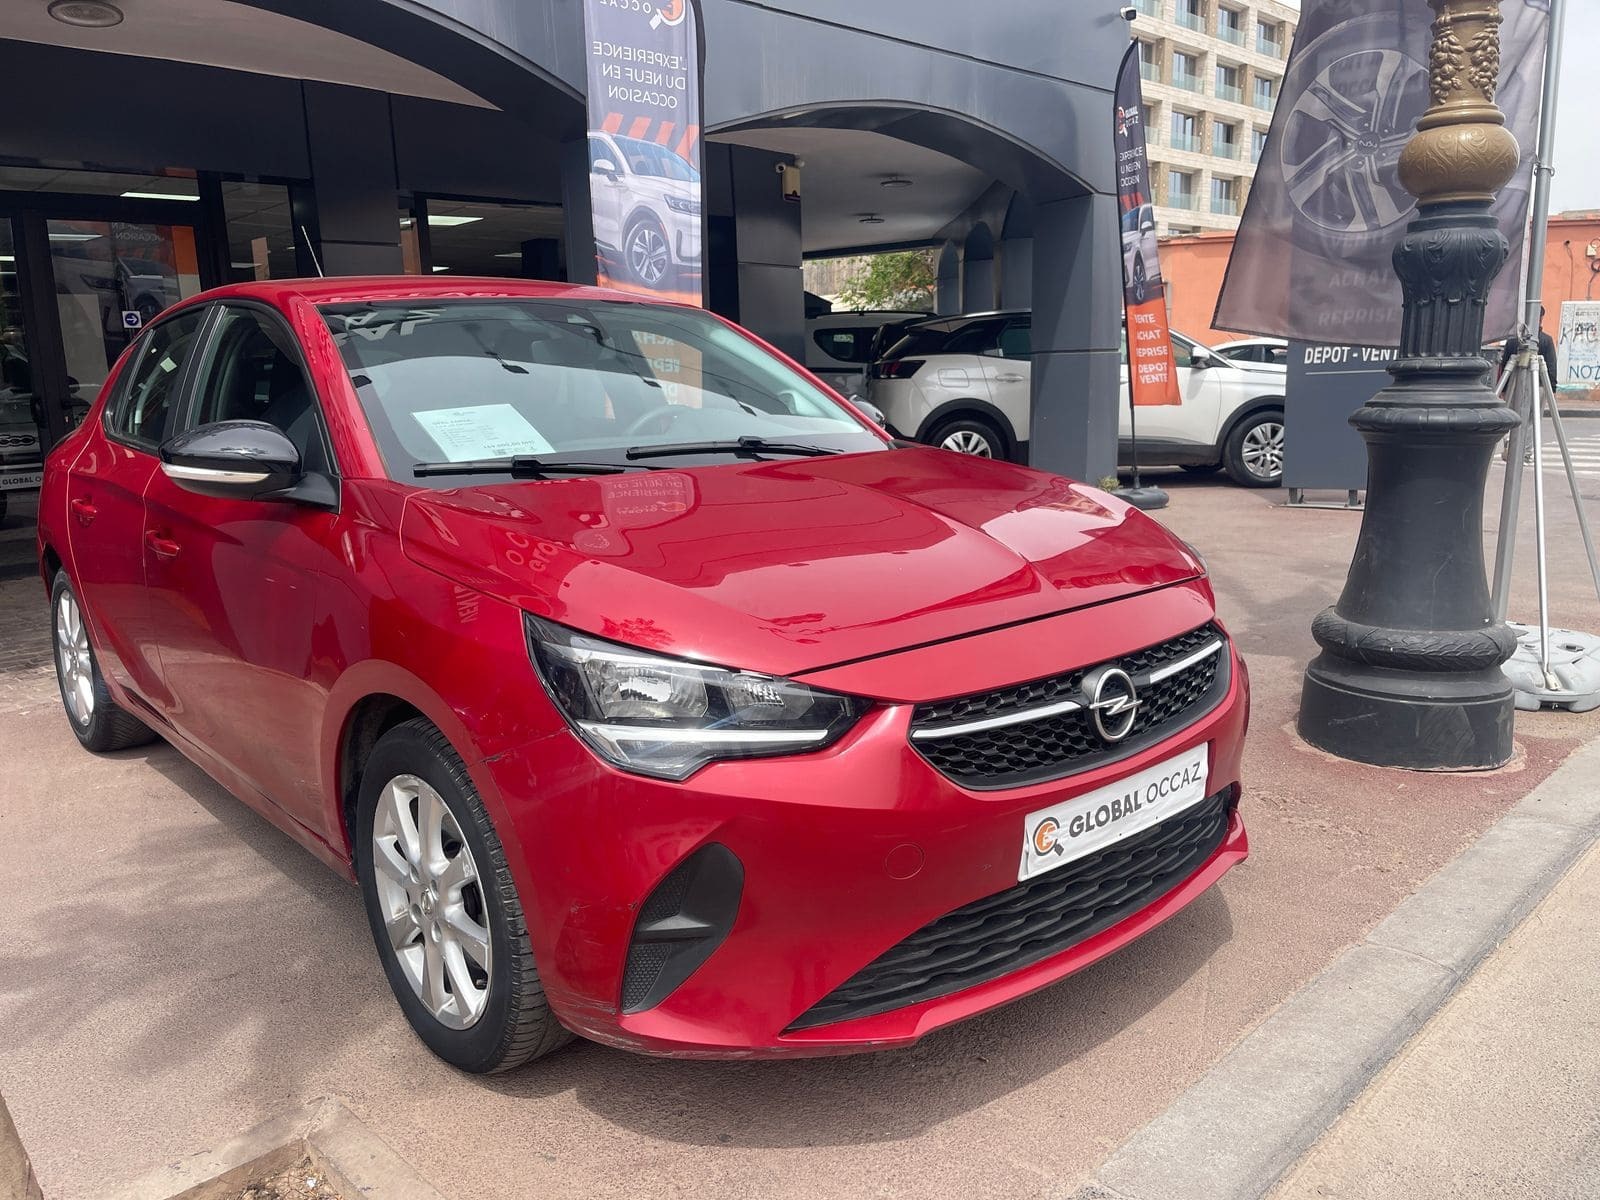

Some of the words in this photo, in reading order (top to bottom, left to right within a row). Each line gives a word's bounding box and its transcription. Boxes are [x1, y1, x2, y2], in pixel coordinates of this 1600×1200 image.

[1303, 346, 1352, 364] DEPOT
[1137, 362, 1168, 374] DEPOT
[1068, 790, 1142, 837] GLOBAL
[1146, 761, 1201, 804] OCCAZ
